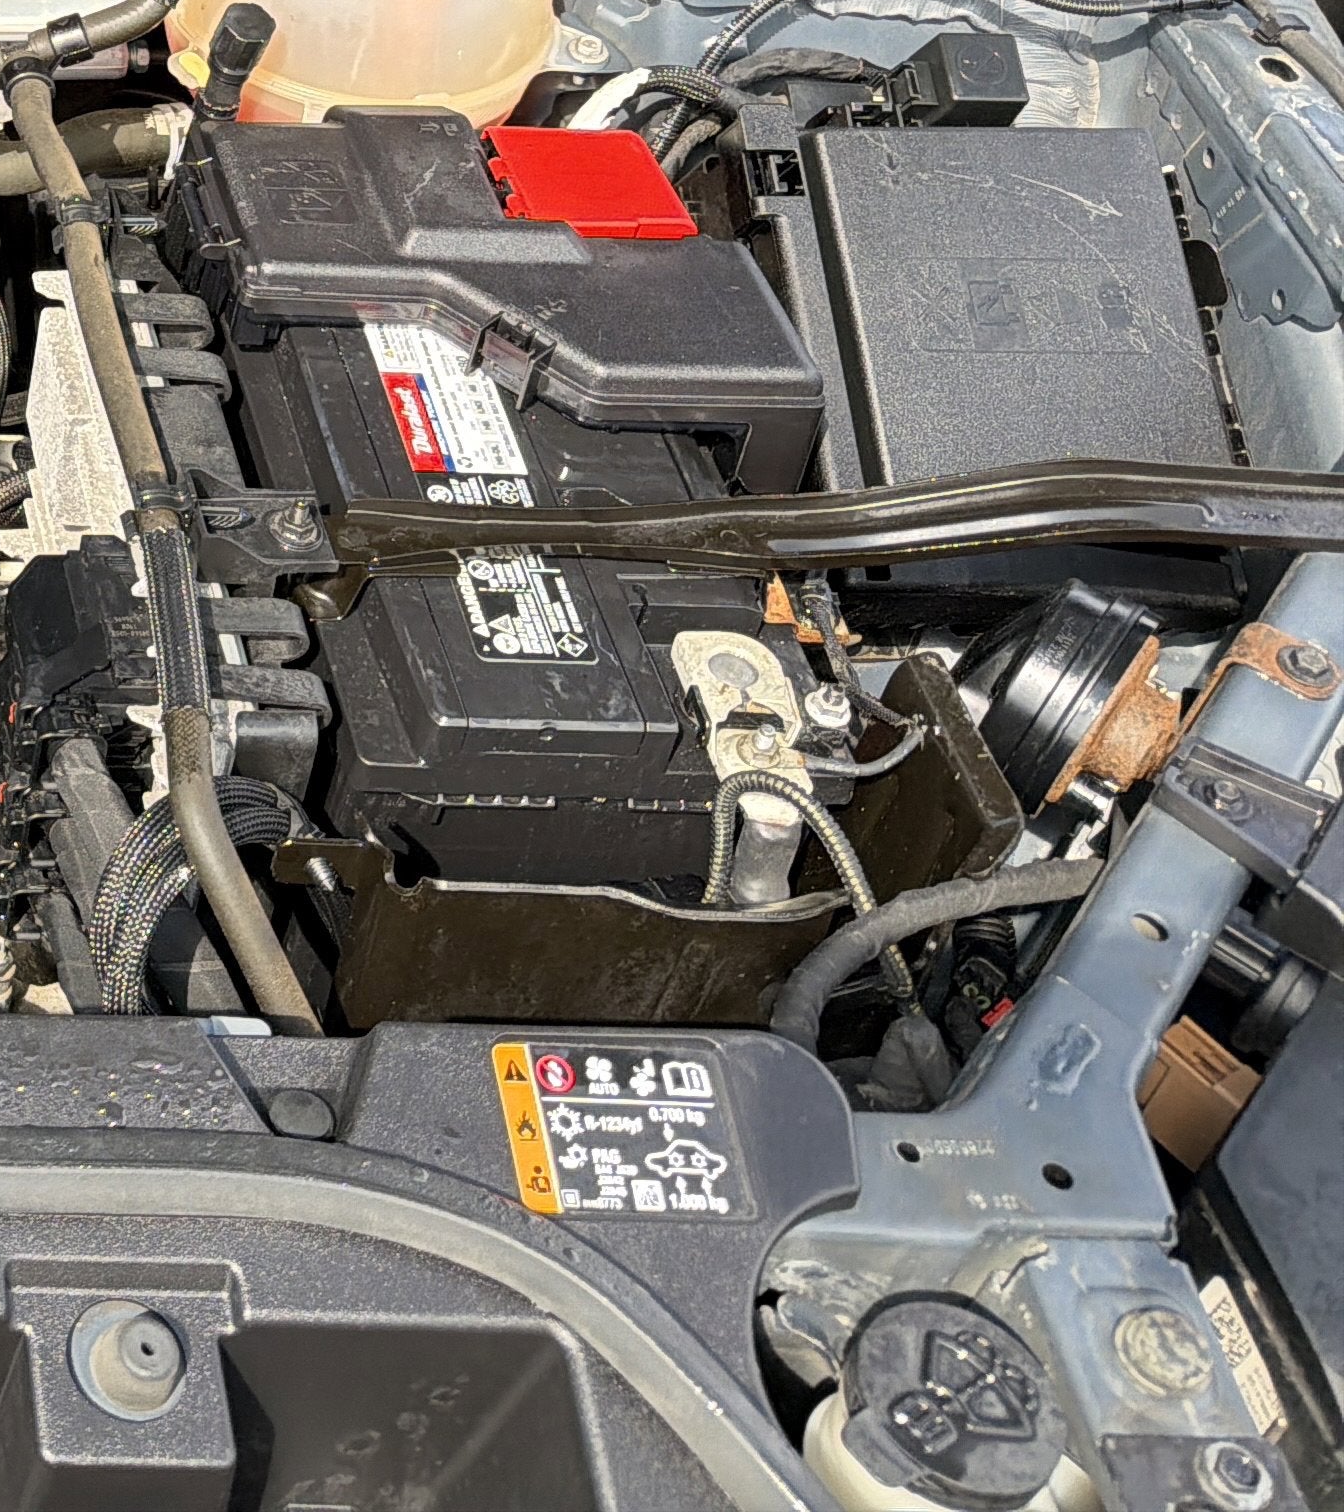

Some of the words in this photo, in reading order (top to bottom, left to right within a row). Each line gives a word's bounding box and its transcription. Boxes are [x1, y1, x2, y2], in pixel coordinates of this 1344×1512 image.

[393, 387, 434, 455] Duralast
[589, 1082, 620, 1096] AUTO
[648, 1106, 685, 1123] 0.700
[686, 1108, 706, 1127] kg
[591, 1148, 622, 1165] PAG
